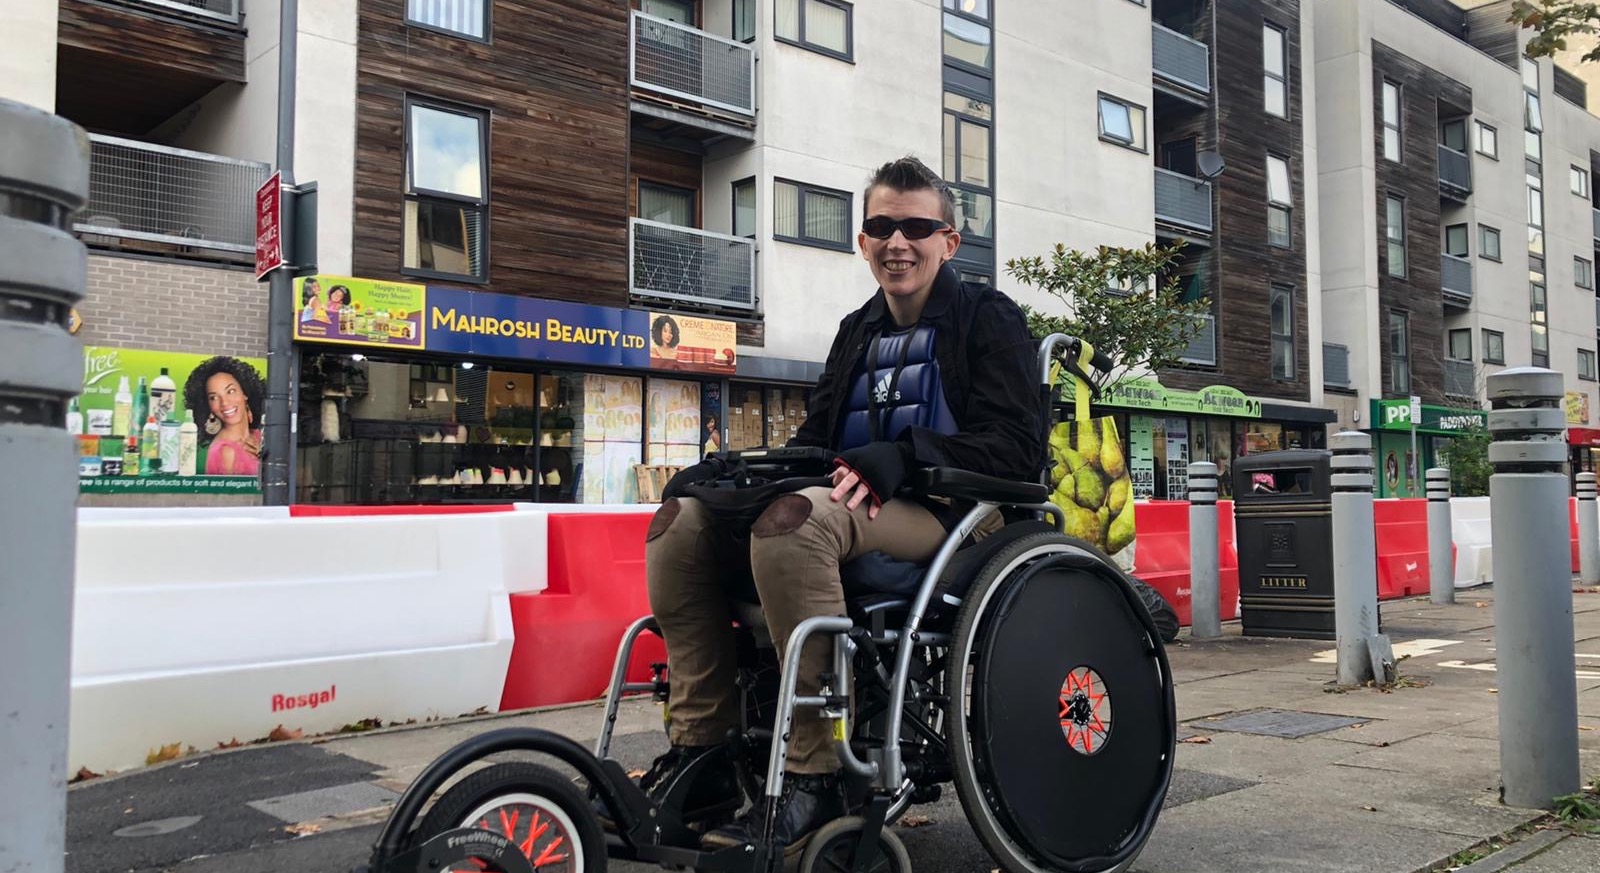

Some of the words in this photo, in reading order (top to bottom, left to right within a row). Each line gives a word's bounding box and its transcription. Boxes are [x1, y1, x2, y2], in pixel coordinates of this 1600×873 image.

[622, 333, 645, 349] LTD
[111, 479, 134, 488] range
[136, 478, 145, 486] of
[146, 479, 180, 489] products
[182, 478, 193, 487] for
[194, 479, 209, 487] soft
[210, 479, 225, 487] and
[226, 479, 252, 489] elegant
[1261, 577, 1306, 587] LITTER
[272, 684, 337, 712] Rosgal
[447, 831, 508, 849] FreeWheel
